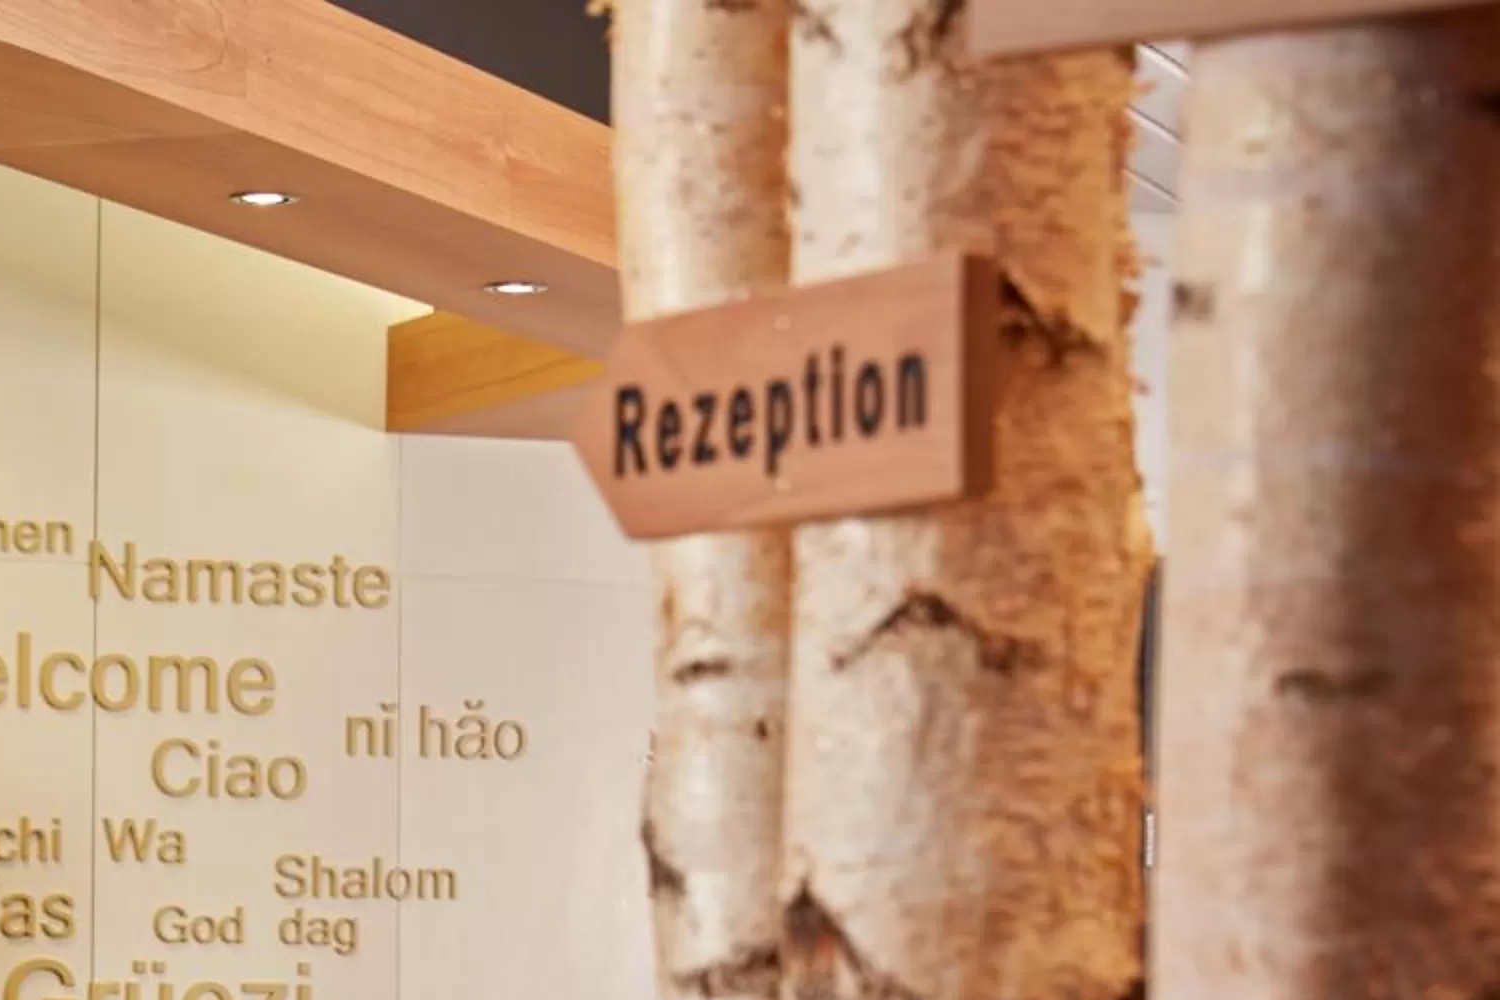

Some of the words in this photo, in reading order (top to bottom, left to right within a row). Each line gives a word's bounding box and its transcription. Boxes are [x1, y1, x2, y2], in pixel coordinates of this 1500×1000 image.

[613, 342, 928, 480] Rezeption
[87, 540, 391, 609] Namaste
[151, 736, 308, 799] Ciao
[102, 817, 187, 866] Wa
[273, 854, 459, 902] Shalom
[153, 905, 245, 947] God
[278, 910, 358, 955] dag
